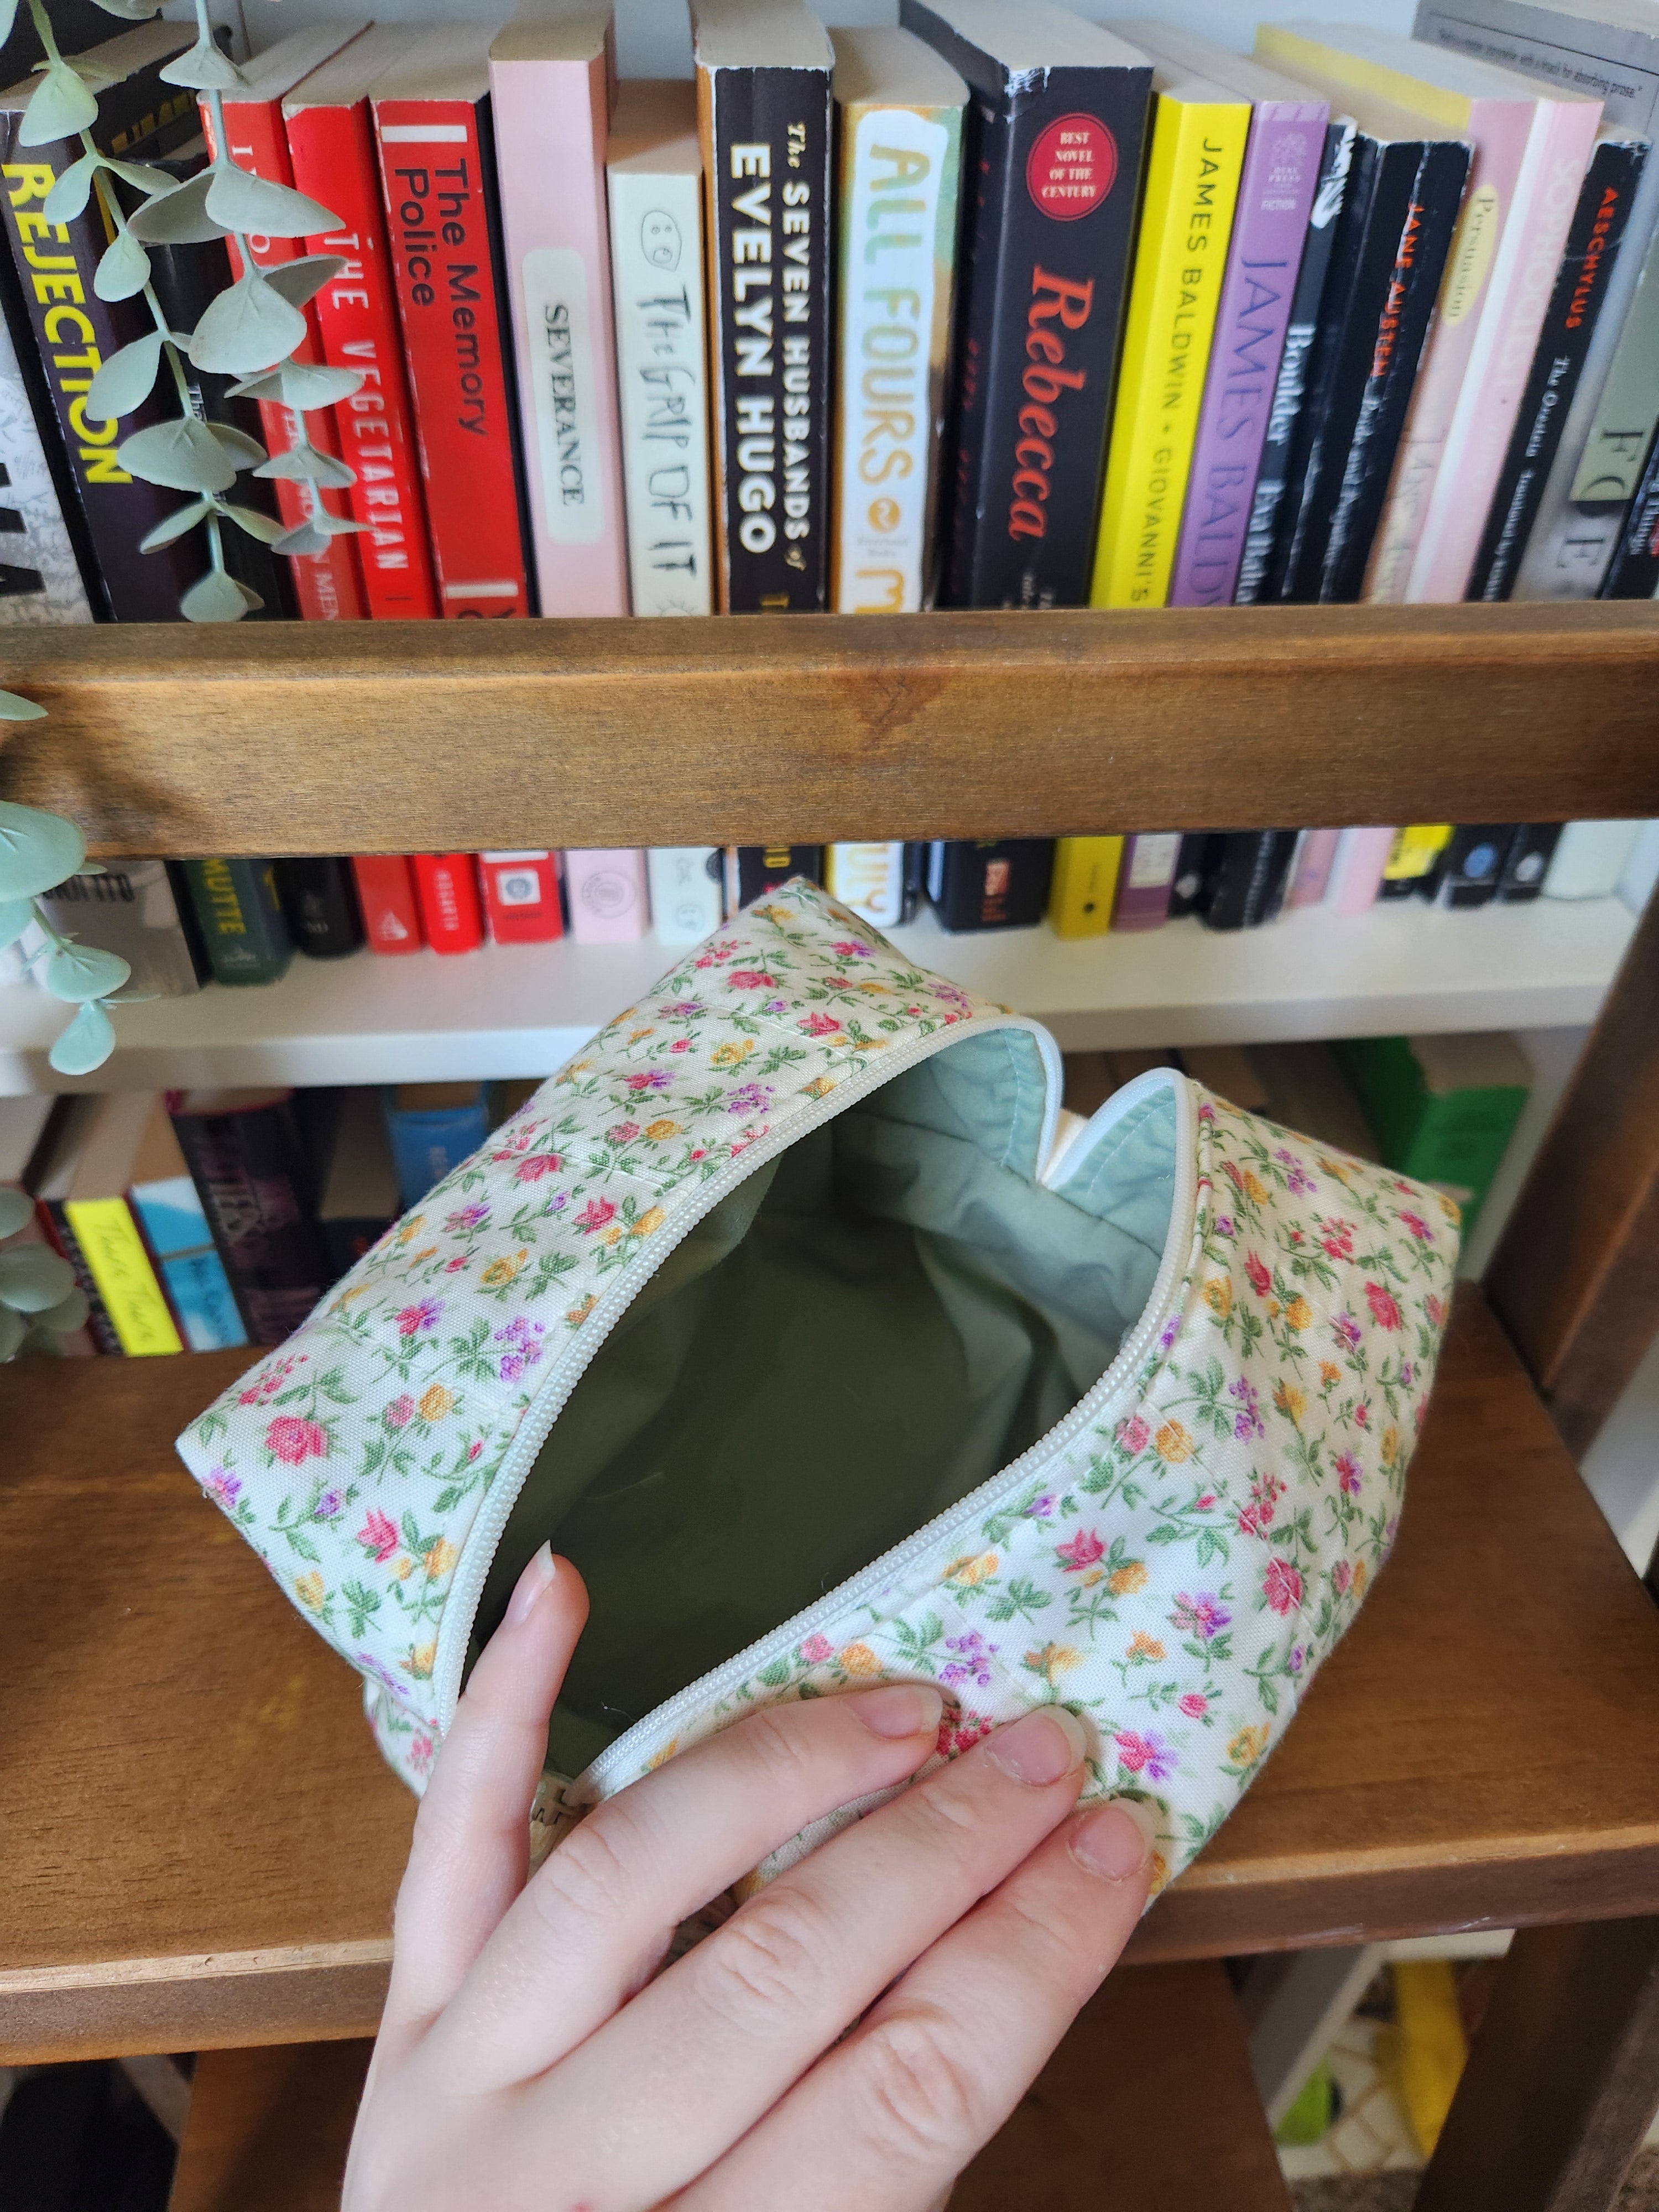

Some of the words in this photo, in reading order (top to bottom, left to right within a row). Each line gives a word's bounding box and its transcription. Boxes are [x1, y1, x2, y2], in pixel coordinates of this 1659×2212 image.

[435, 158, 469, 247] The
[787, 121, 806, 168] The
[864, 143, 931, 265] ALL
[1041, 185, 1097, 199] CENTURY
[1049, 168, 1067, 180] OF
[1068, 168, 1094, 180] THE
[1055, 150, 1095, 163] NOVEL
[1060, 132, 1091, 145] BEST
[1187, 137, 1223, 253] JAMES
[323, 233, 369, 310] THE
[394, 168, 438, 307] Police
[730, 142, 774, 377] EVELYN
[782, 180, 811, 322] SEVEN
[1395, 200, 1426, 269] JANE
[1564, 186, 1619, 330] AESCHYLUS
[2, 164, 133, 484] REJECTION
[446, 264, 489, 437] Memory
[858, 289, 921, 486] FOURS
[1162, 268, 1203, 410] BALDWIN
[1217, 257, 1288, 440] JAMES
[1370, 280, 1406, 377] AUSTEN
[341, 340, 410, 569] VEGETARIAN
[544, 303, 585, 507] SEVERANCE
[782, 335, 811, 540] HUSBANDS
[1008, 263, 1095, 542] Rebecca
[648, 465, 693, 521] OF
[735, 394, 776, 554] HUGO
[1130, 447, 1172, 602] GIOVANNI'S
[1190, 463, 1248, 607] BALD
[648, 540, 697, 579] IT
